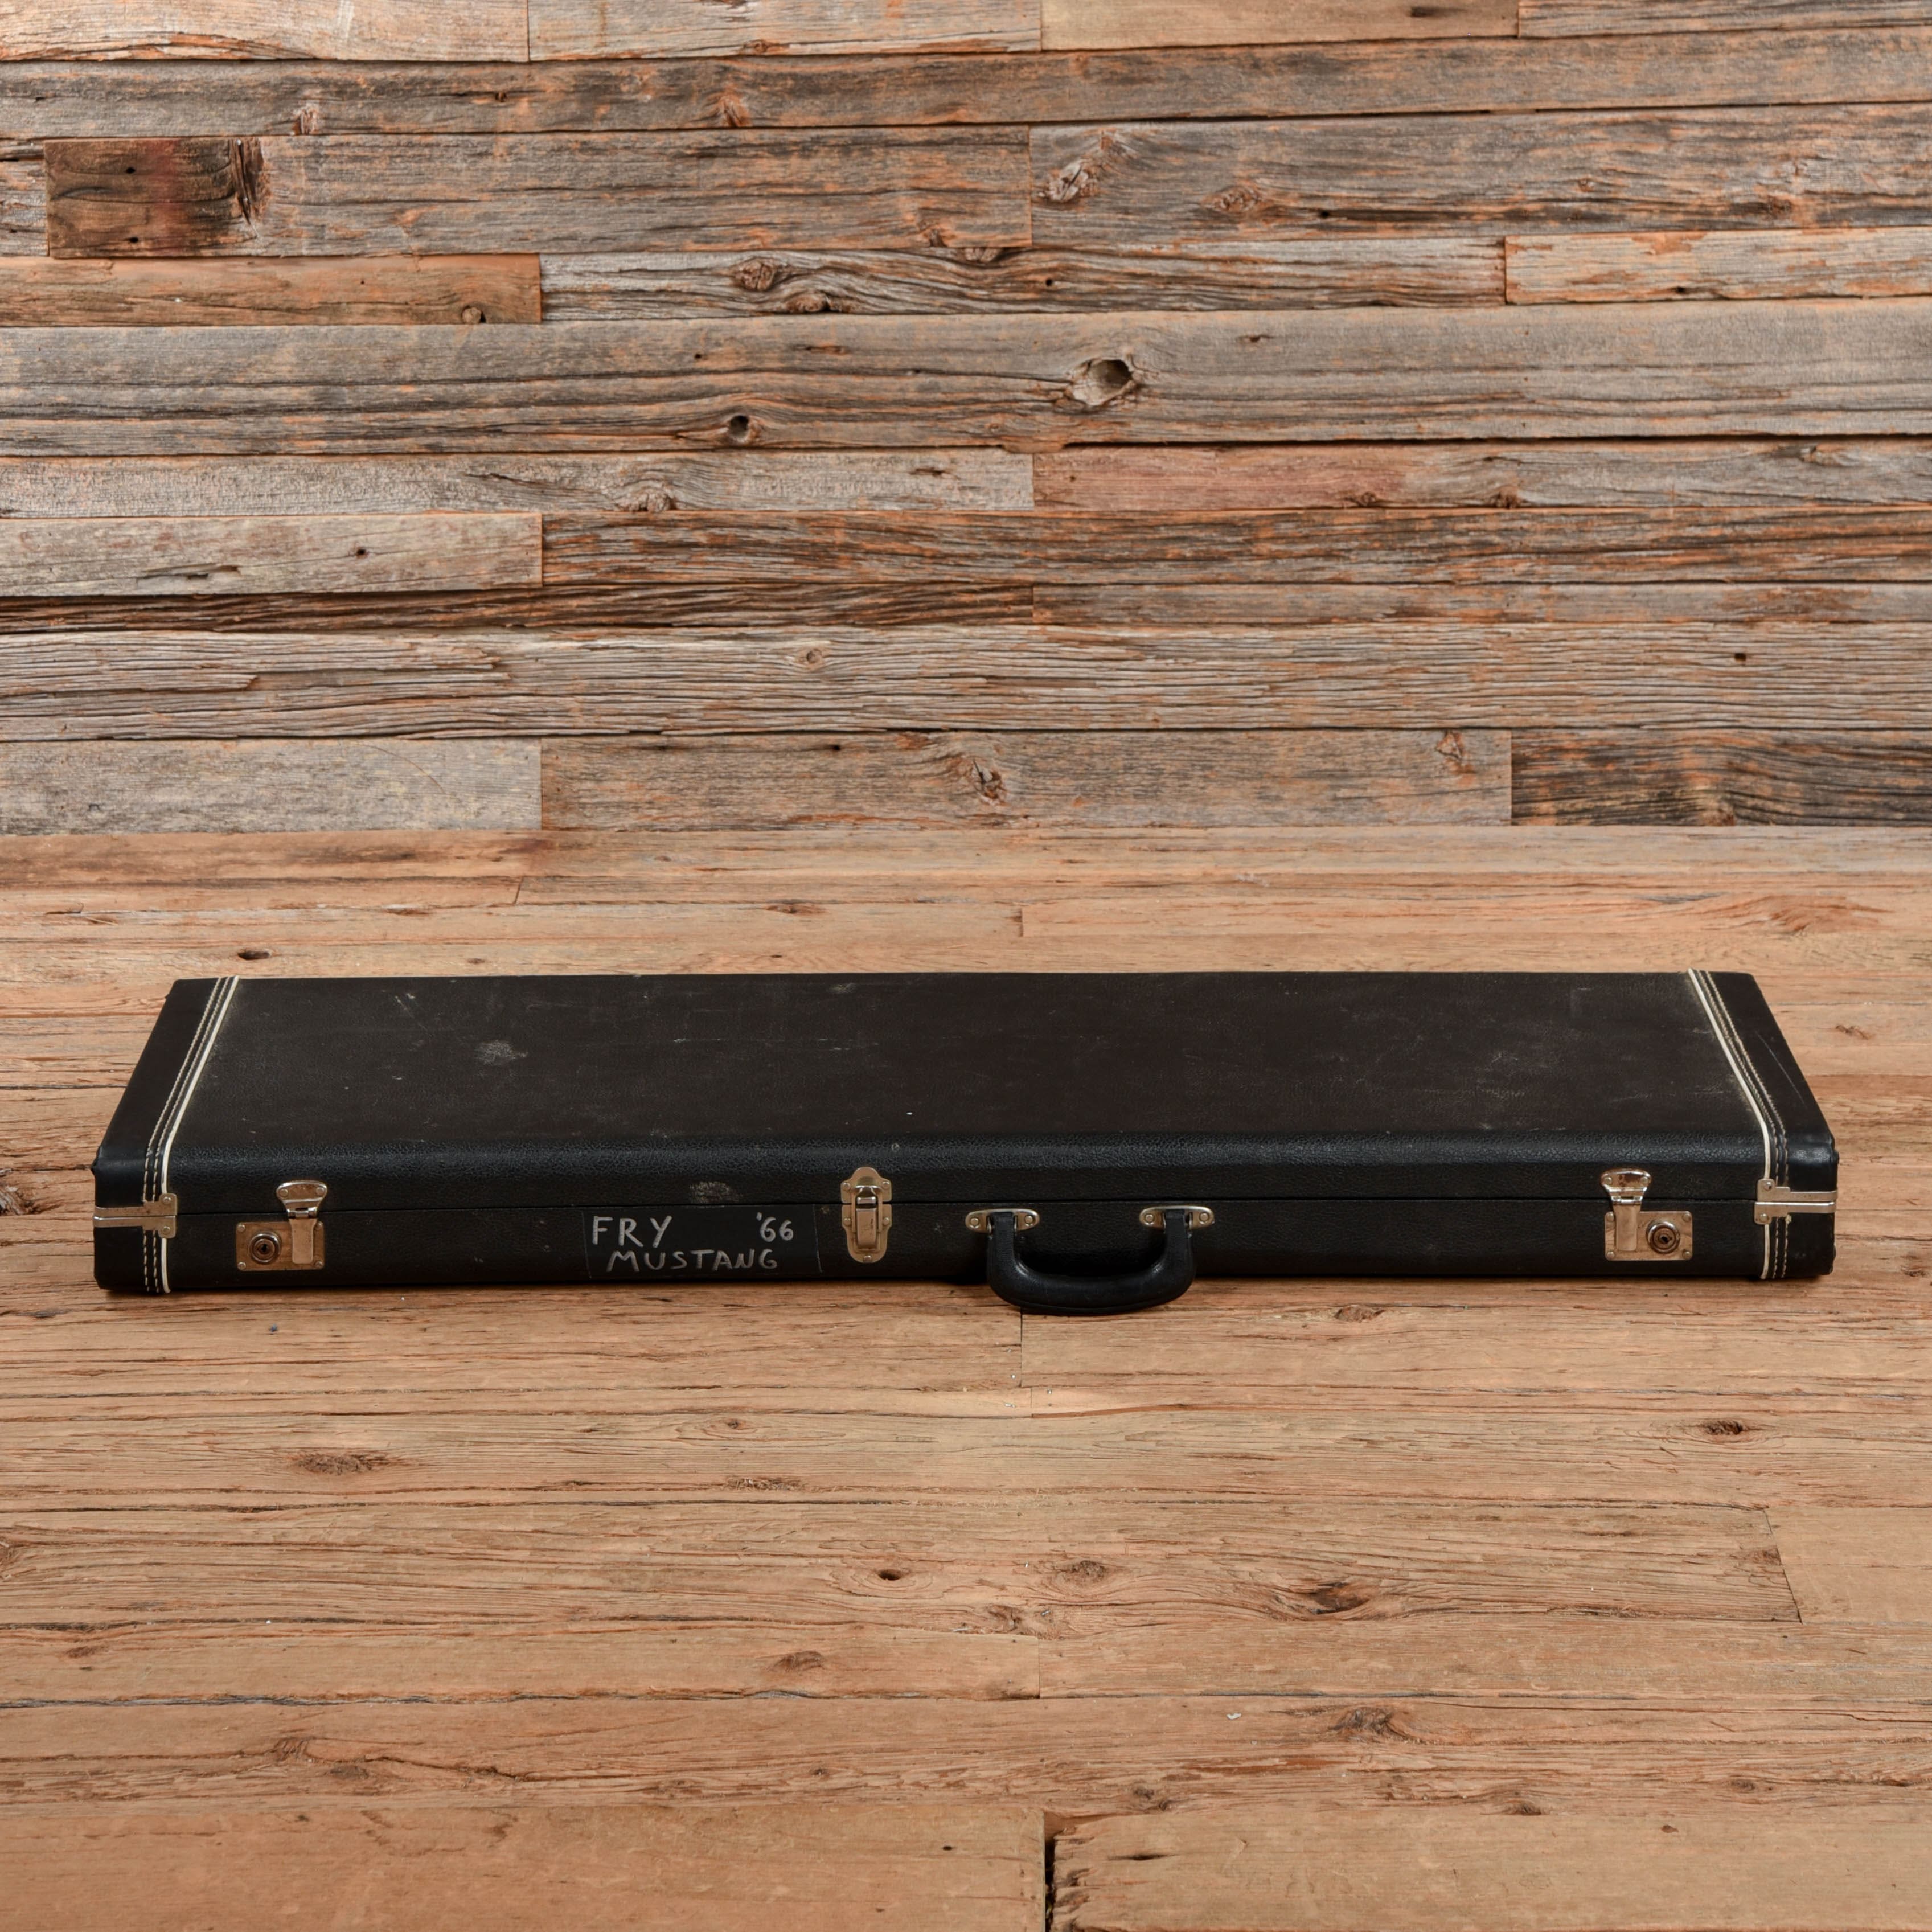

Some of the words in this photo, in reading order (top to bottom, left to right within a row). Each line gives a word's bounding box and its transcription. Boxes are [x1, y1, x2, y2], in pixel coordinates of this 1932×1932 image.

[592, 1215, 672, 1248] FRY
[756, 1212, 794, 1242] '66
[606, 1248, 778, 1273] MUSTANG
